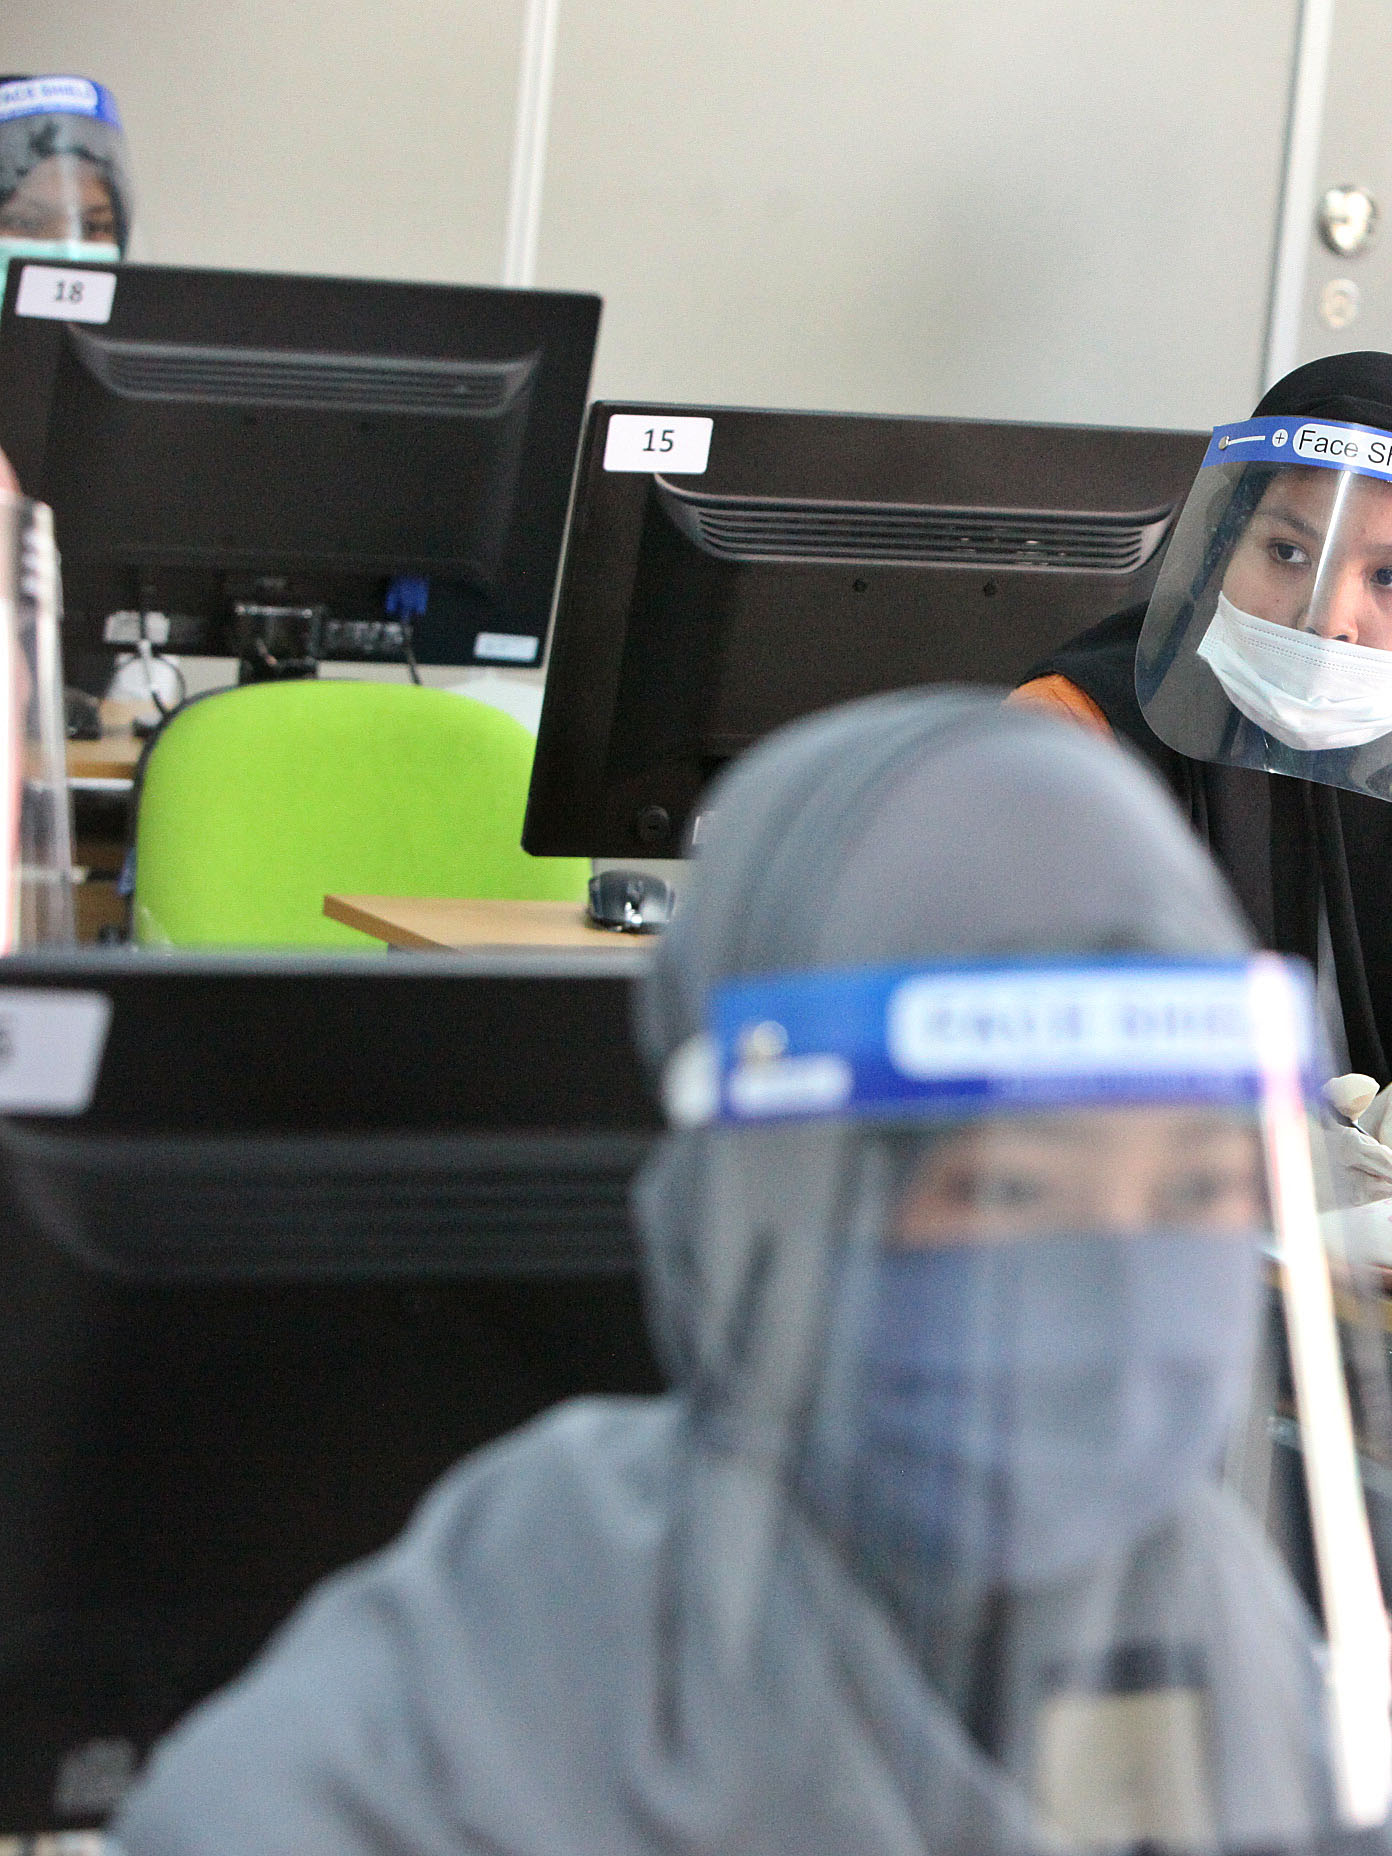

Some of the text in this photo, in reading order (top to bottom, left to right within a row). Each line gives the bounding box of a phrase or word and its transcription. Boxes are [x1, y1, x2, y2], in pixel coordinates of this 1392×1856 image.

[54, 279, 85, 304] 18
[642, 427, 676, 453] 15
[1298, 429, 1359, 458] Face
